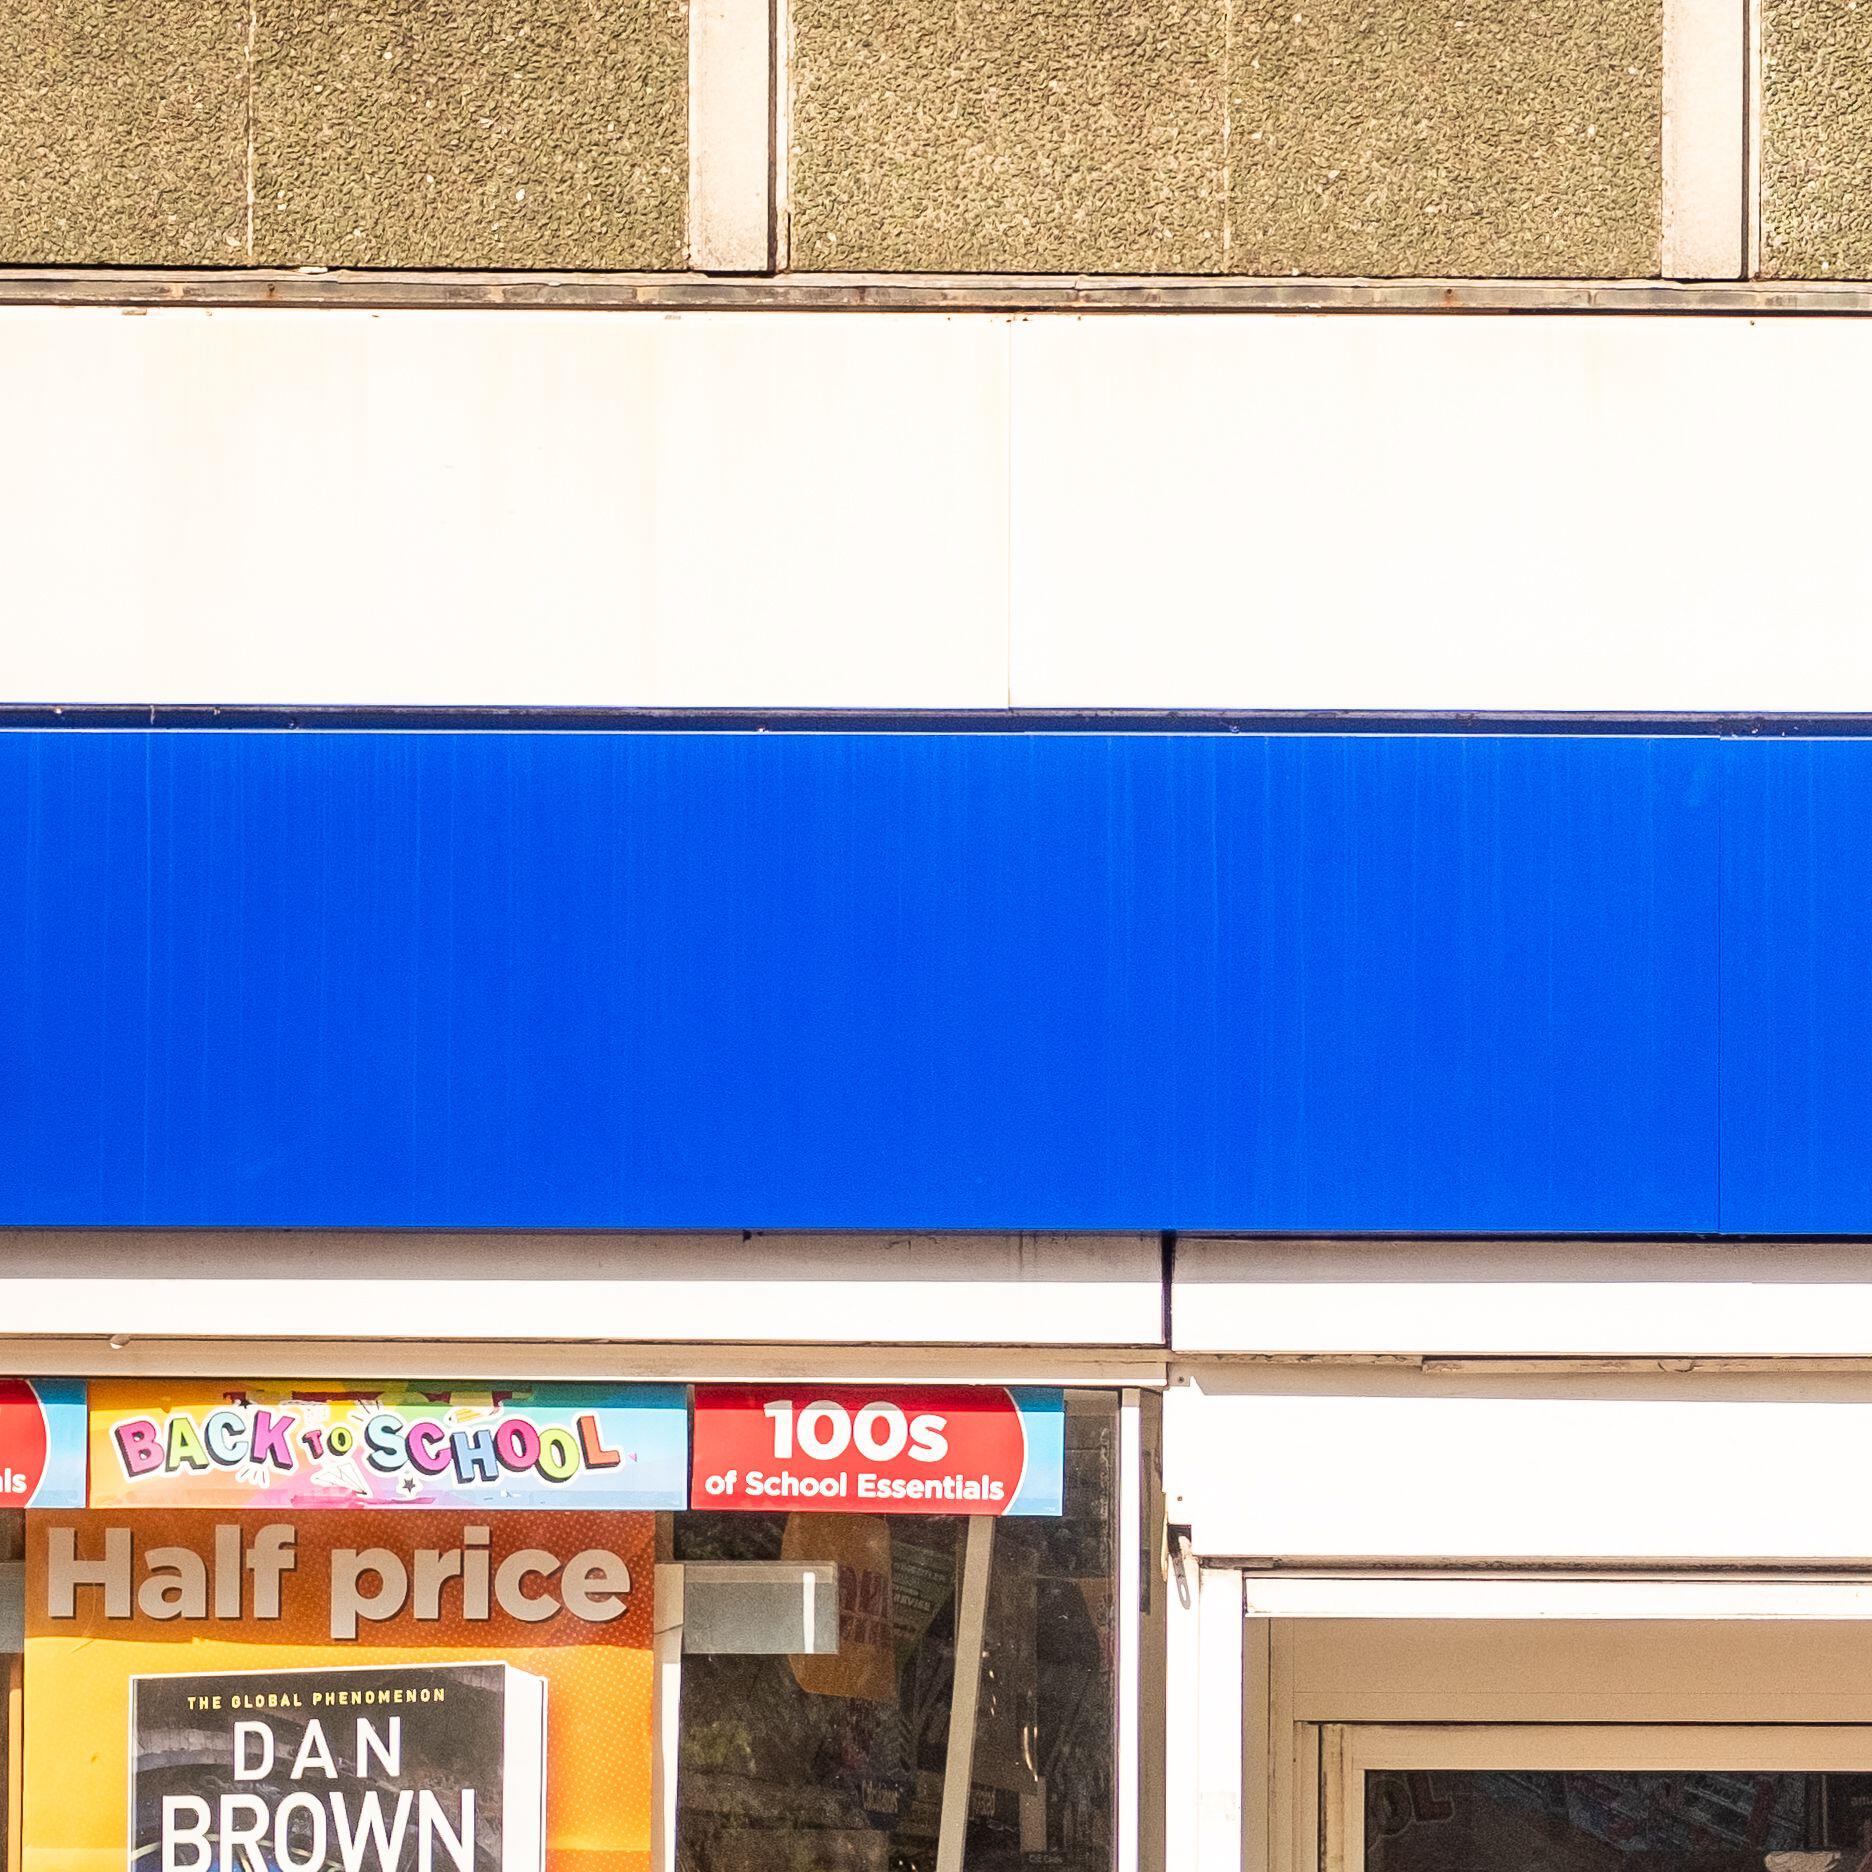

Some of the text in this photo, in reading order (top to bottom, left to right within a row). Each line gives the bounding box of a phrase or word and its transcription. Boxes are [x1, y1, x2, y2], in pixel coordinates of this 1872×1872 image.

[117, 1411, 621, 1485] BACK TO SCHOOL
[764, 1400, 948, 1462] 100s
[705, 1470, 1004, 1500] of School Essentials
[46, 1523, 631, 1639] Half price
[188, 1688, 446, 1709] THE GLOBAL PHENOMENON
[233, 1715, 402, 1781] DAN
